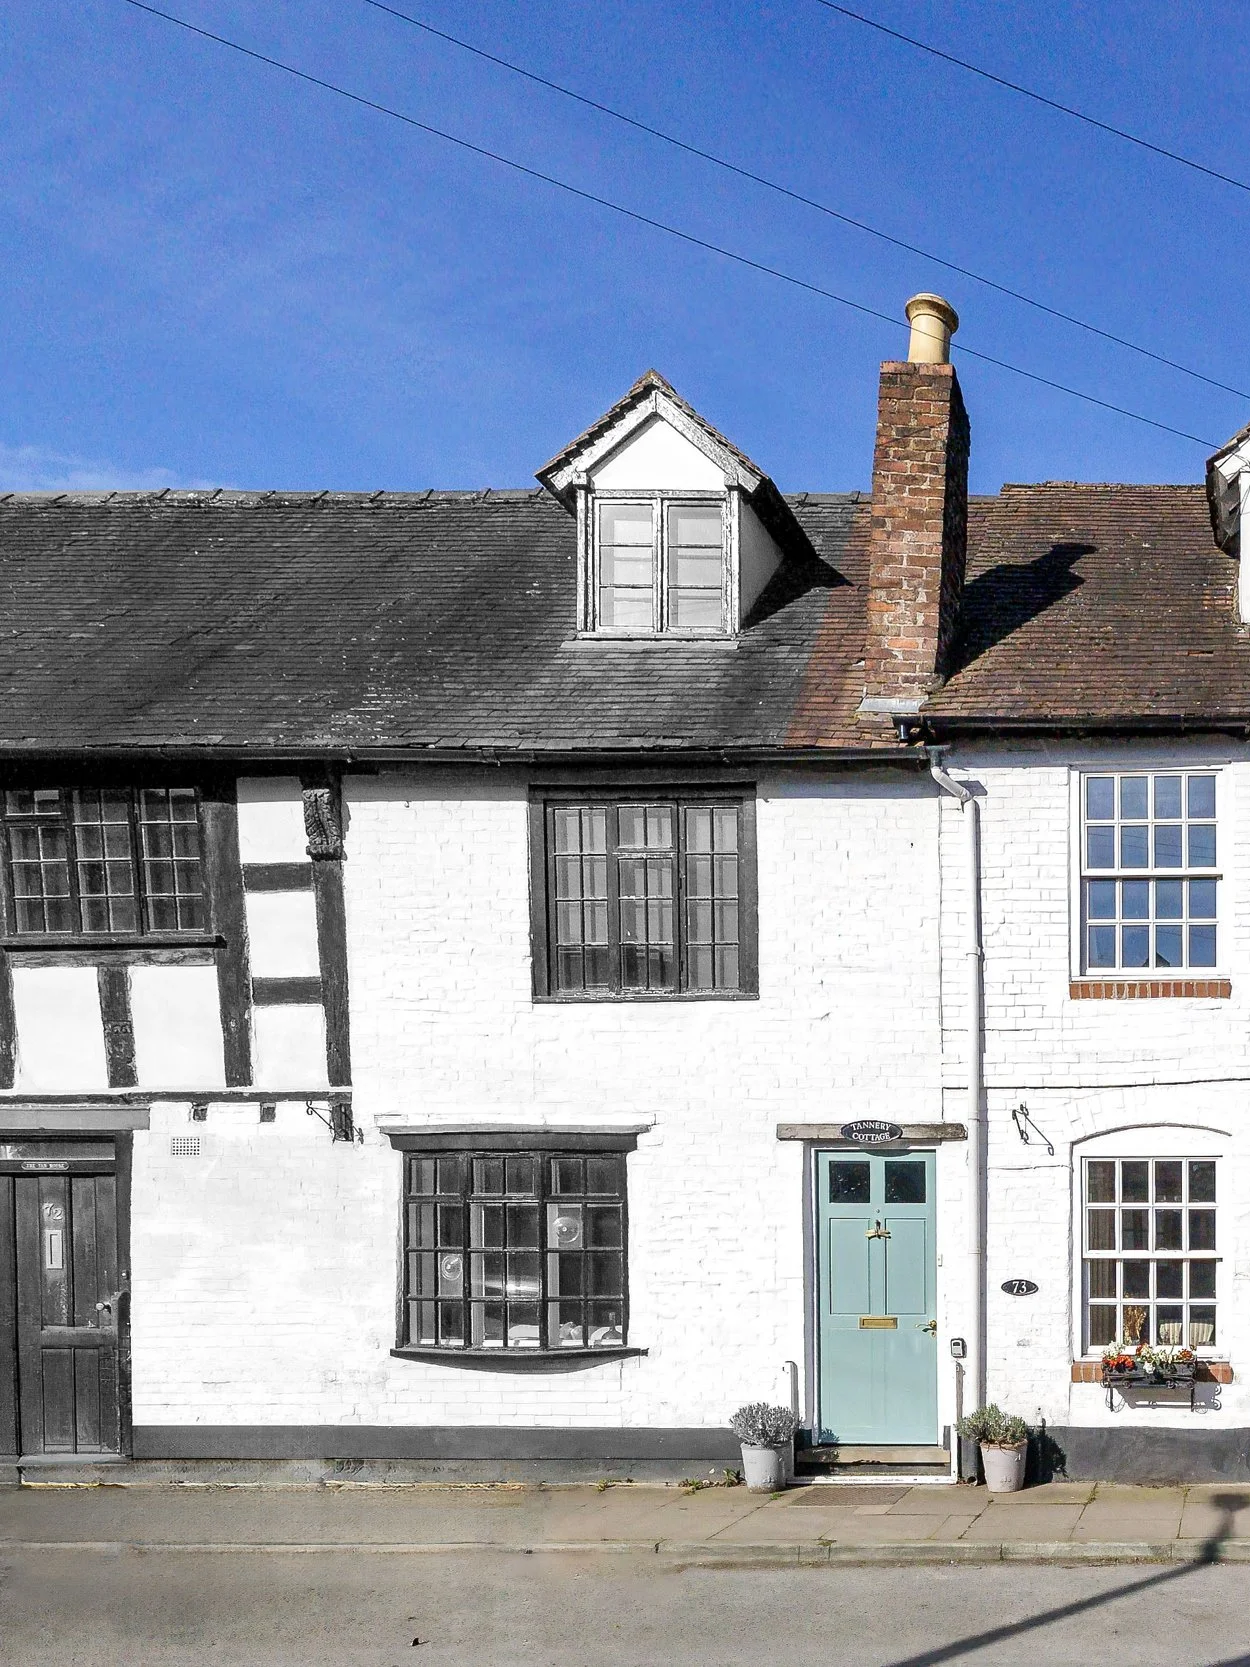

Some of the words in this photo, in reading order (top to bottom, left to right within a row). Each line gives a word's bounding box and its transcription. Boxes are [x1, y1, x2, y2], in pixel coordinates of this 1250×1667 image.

[851, 1121, 891, 1131] TANNERY
[852, 1132, 891, 1141] COTTAGE
[43, 1202, 63, 1220] 72
[1012, 1281, 1027, 1294] 73
